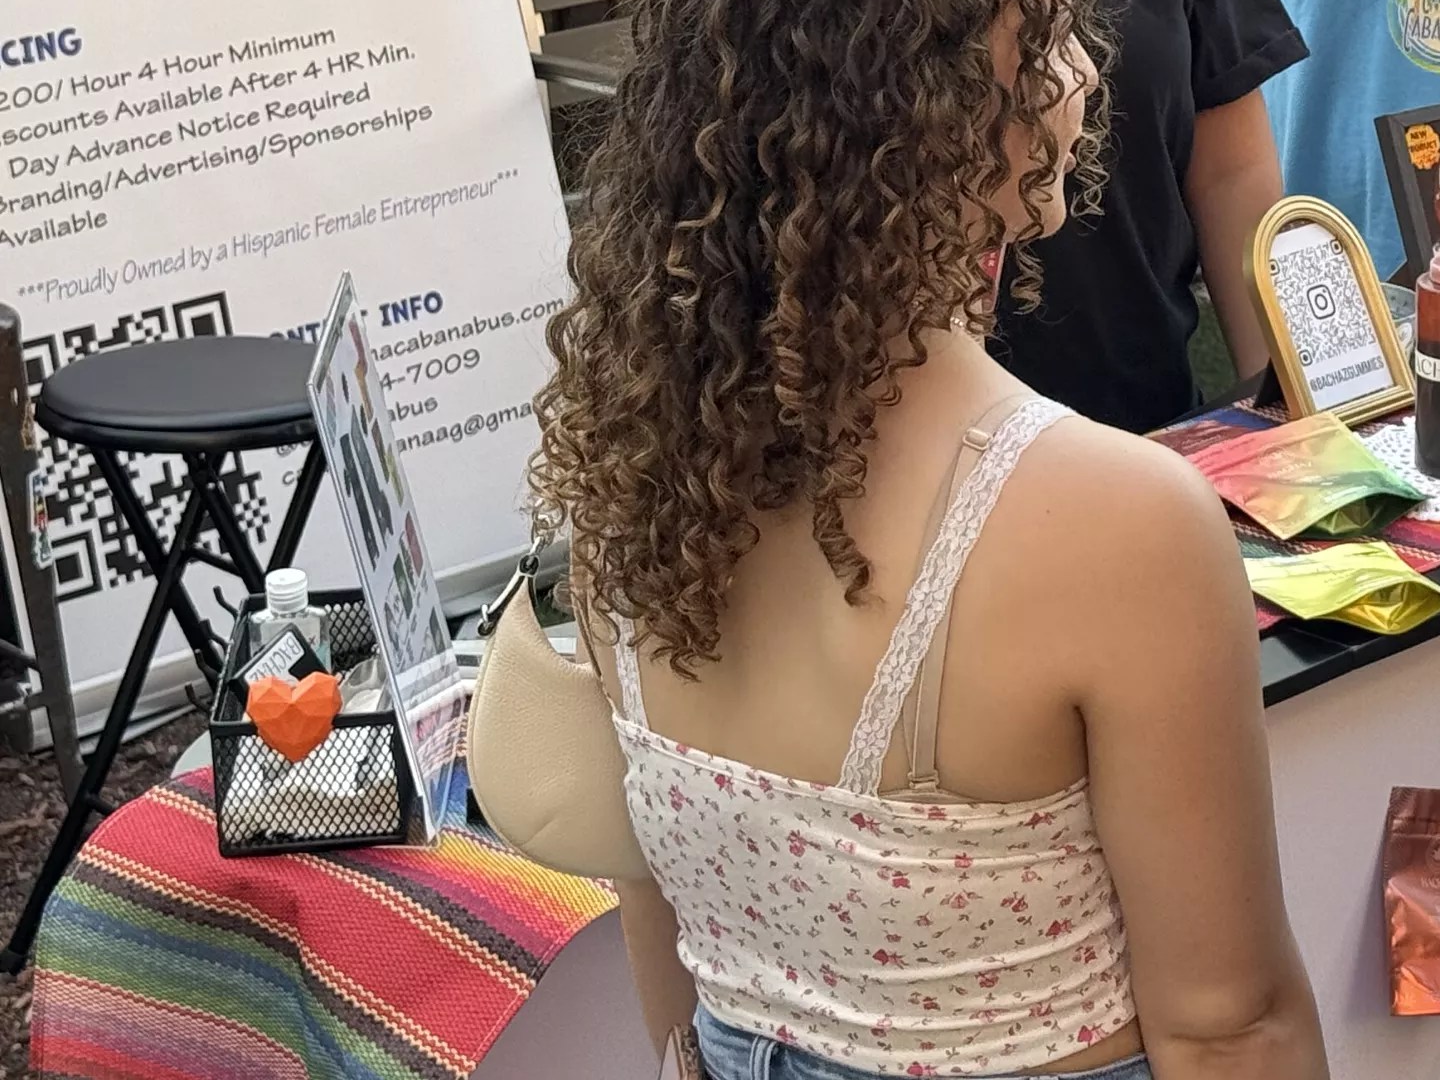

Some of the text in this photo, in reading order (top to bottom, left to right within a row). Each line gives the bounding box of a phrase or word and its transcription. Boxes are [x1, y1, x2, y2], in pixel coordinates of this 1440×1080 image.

[0, 44, 416, 148] scounts Available After 4 HR Min.
[70, 71, 132, 96] Hour
[138, 61, 158, 82] 4
[163, 51, 224, 76] Hour
[229, 29, 336, 64] Minimum
[8, 81, 371, 179] Day Advance Notice Required
[0, 209, 108, 249] Available
[122, 248, 186, 285] Owned
[189, 245, 213, 271] by
[215, 243, 228, 261] a
[233, 221, 311, 258] Hispanic
[314, 204, 377, 238] Female
[379, 290, 443, 327] INFO
